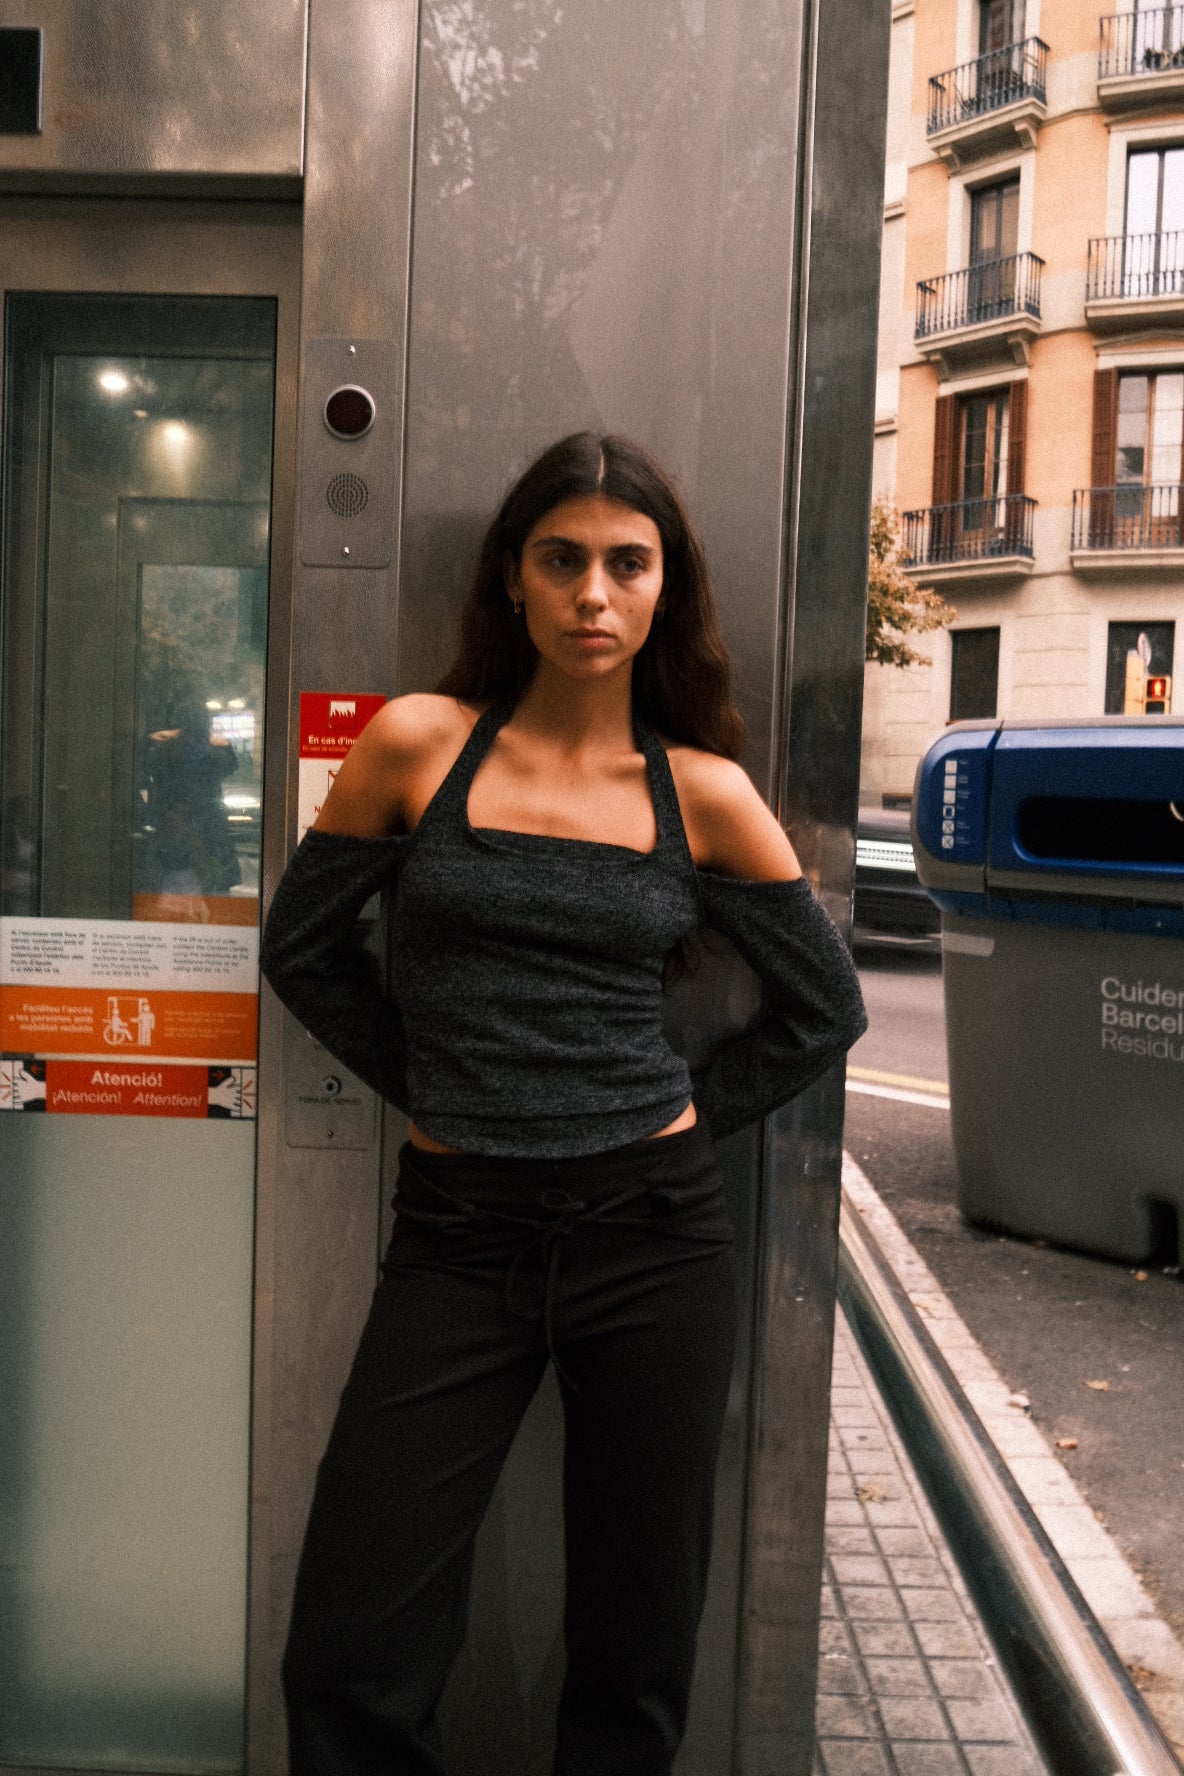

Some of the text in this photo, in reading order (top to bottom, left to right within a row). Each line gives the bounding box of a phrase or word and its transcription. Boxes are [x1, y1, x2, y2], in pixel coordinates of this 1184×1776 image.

[308, 735, 319, 745] En
[321, 736, 336, 745] cas
[91, 1070, 163, 1088] Atenció!
[53, 1089, 203, 1107] ¡Atención! Attention!
